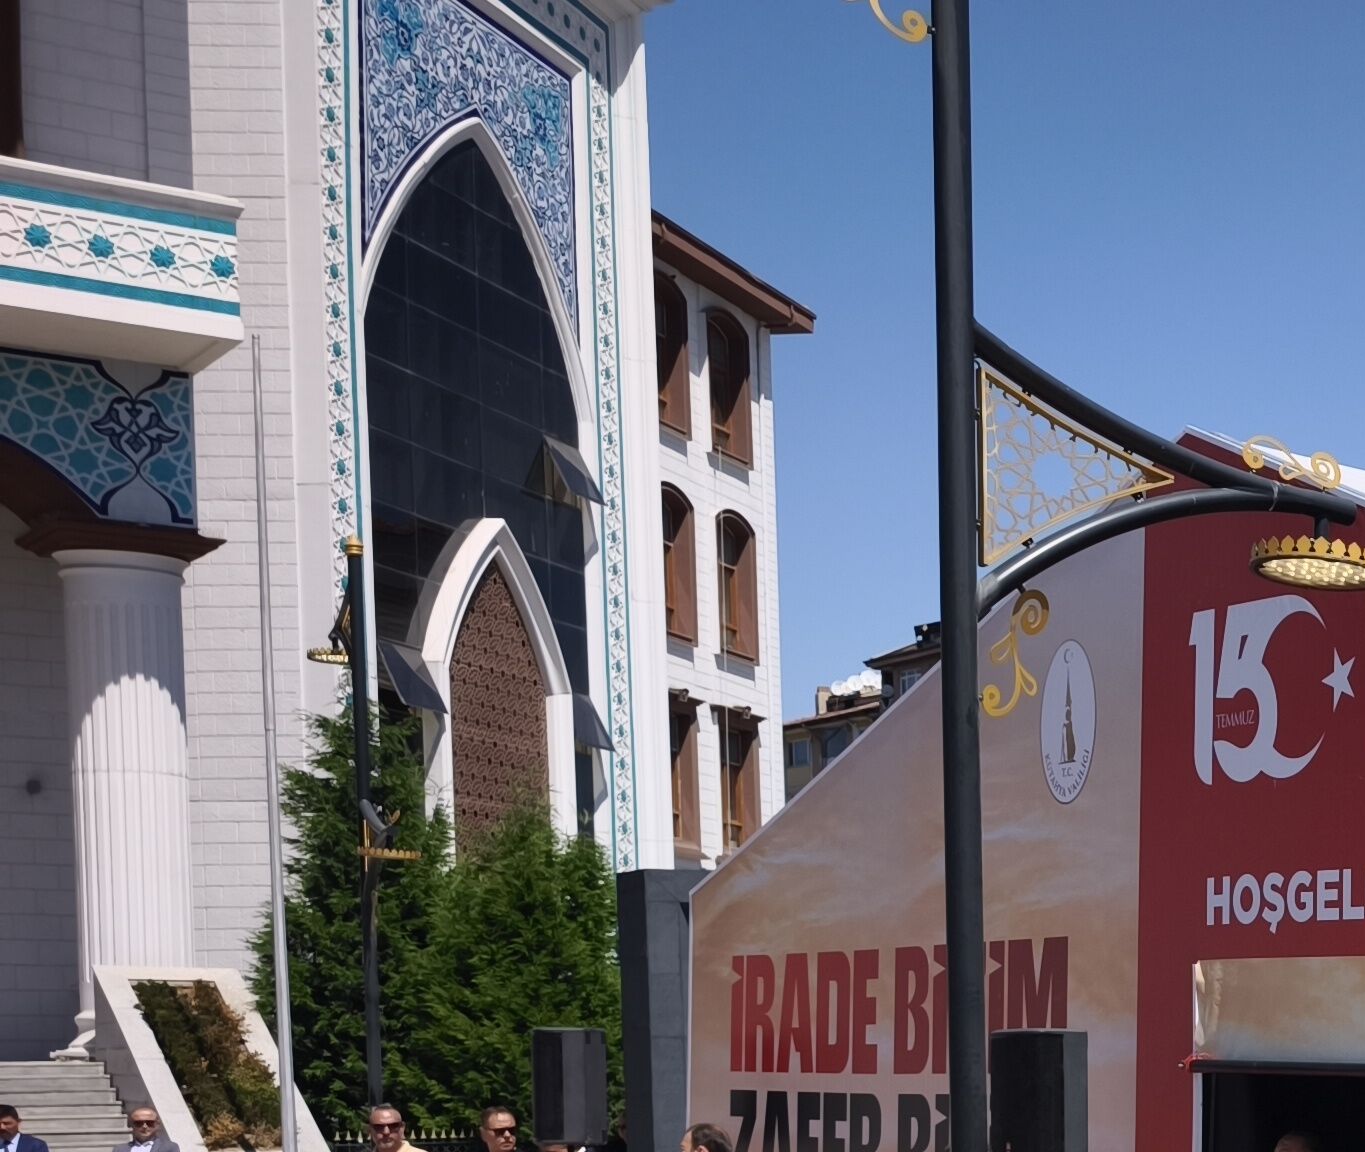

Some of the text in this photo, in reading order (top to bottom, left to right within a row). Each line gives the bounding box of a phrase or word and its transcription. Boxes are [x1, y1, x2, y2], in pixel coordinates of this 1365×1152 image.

[1216, 710, 1255, 729] TEMMUZ
[730, 936, 1069, 1075] İRADE BİİM
